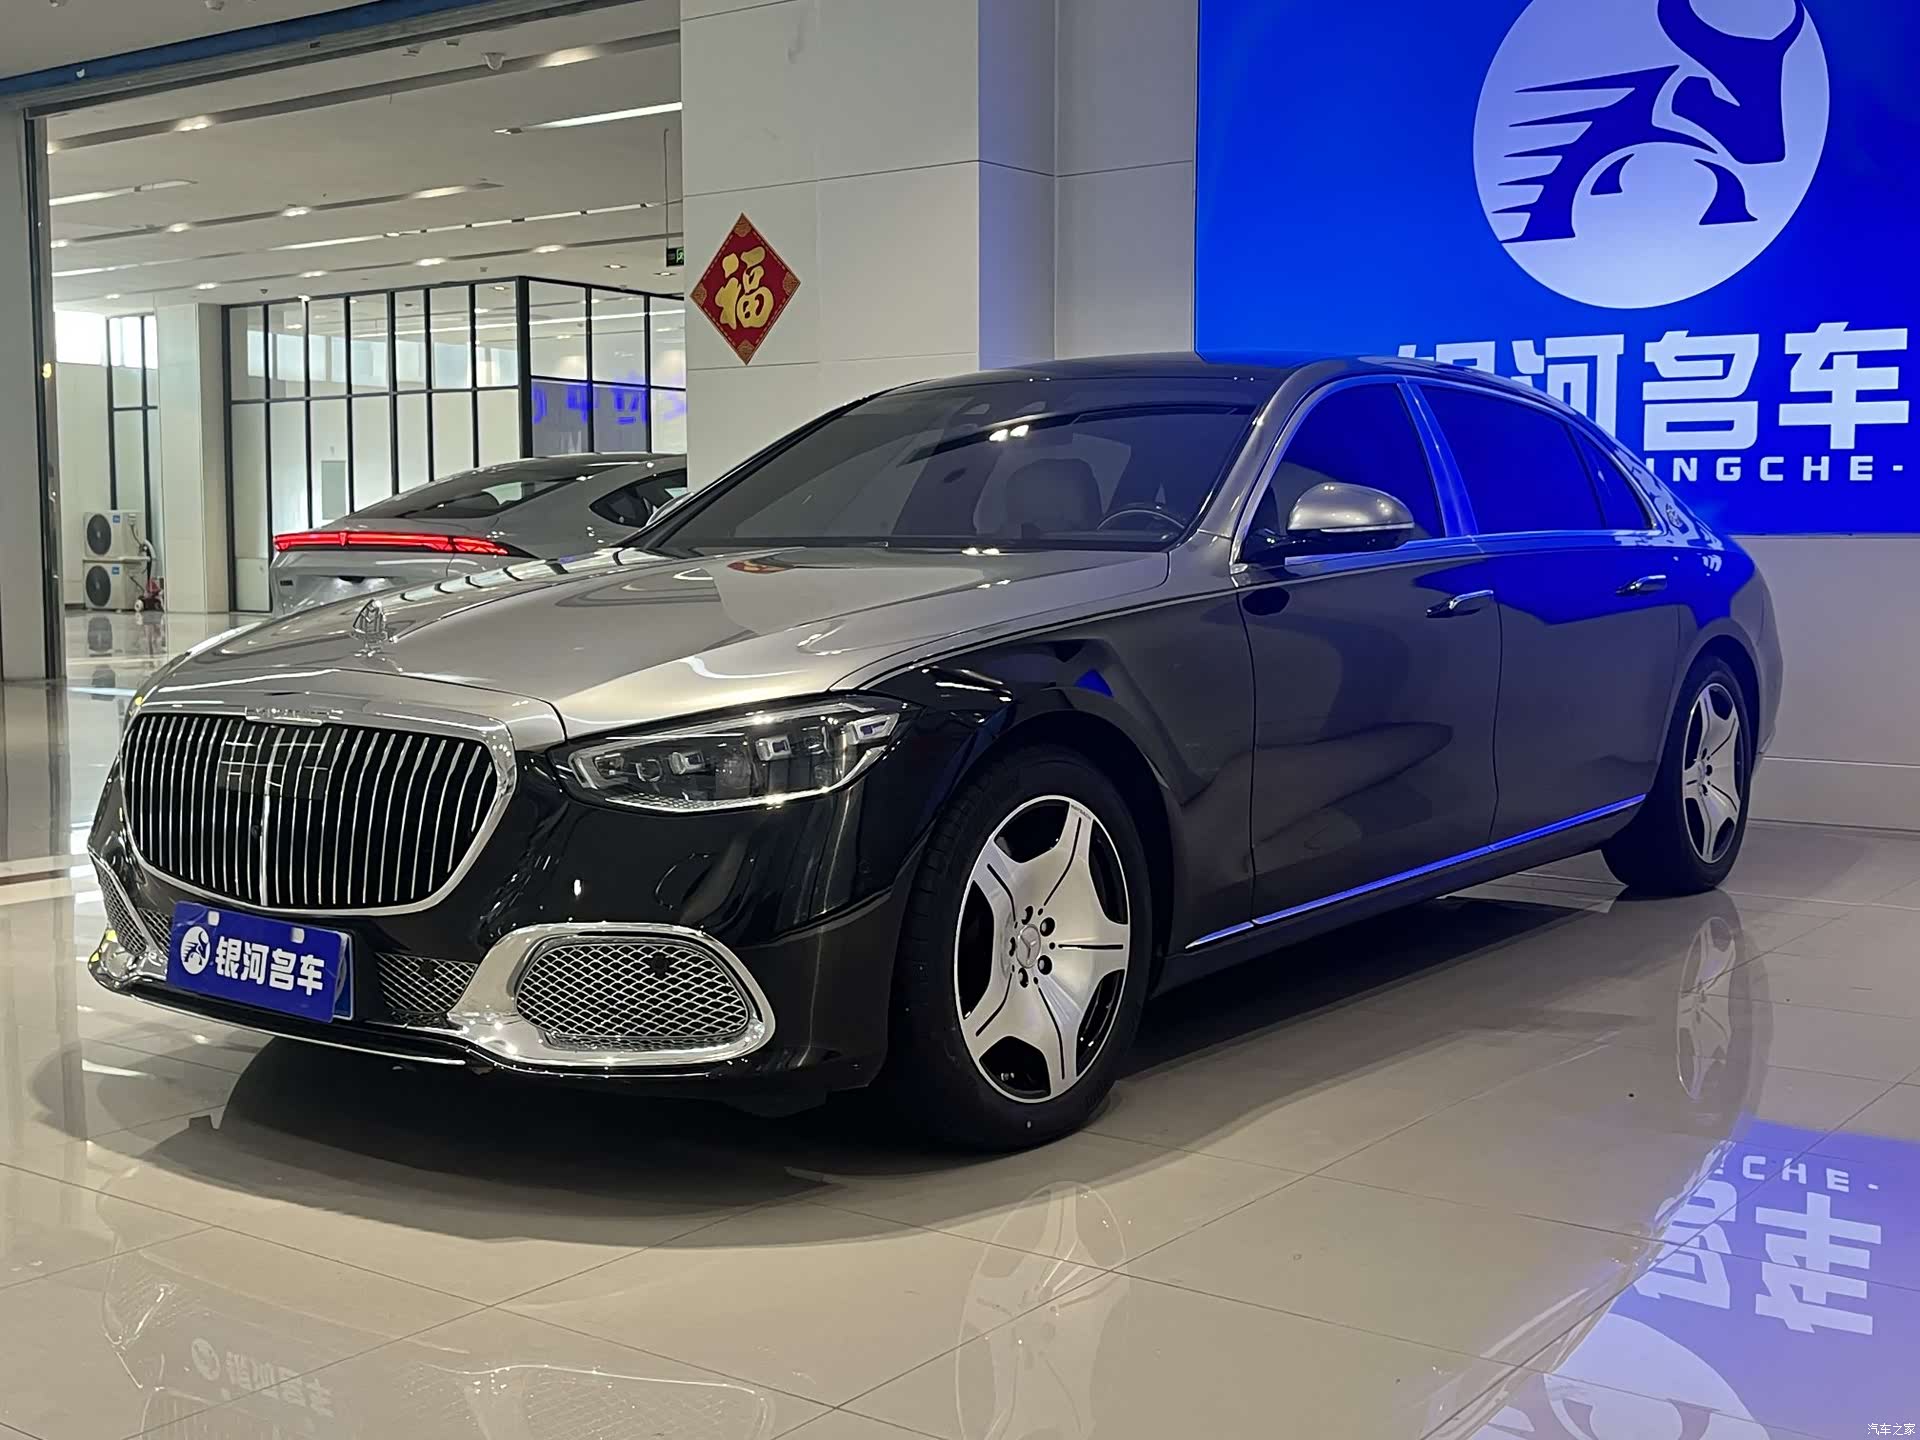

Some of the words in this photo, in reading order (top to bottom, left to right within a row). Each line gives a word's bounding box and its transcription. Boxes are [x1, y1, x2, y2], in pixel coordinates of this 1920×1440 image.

[714, 246, 774, 330] 福
[215, 936, 325, 996] 银河名车
